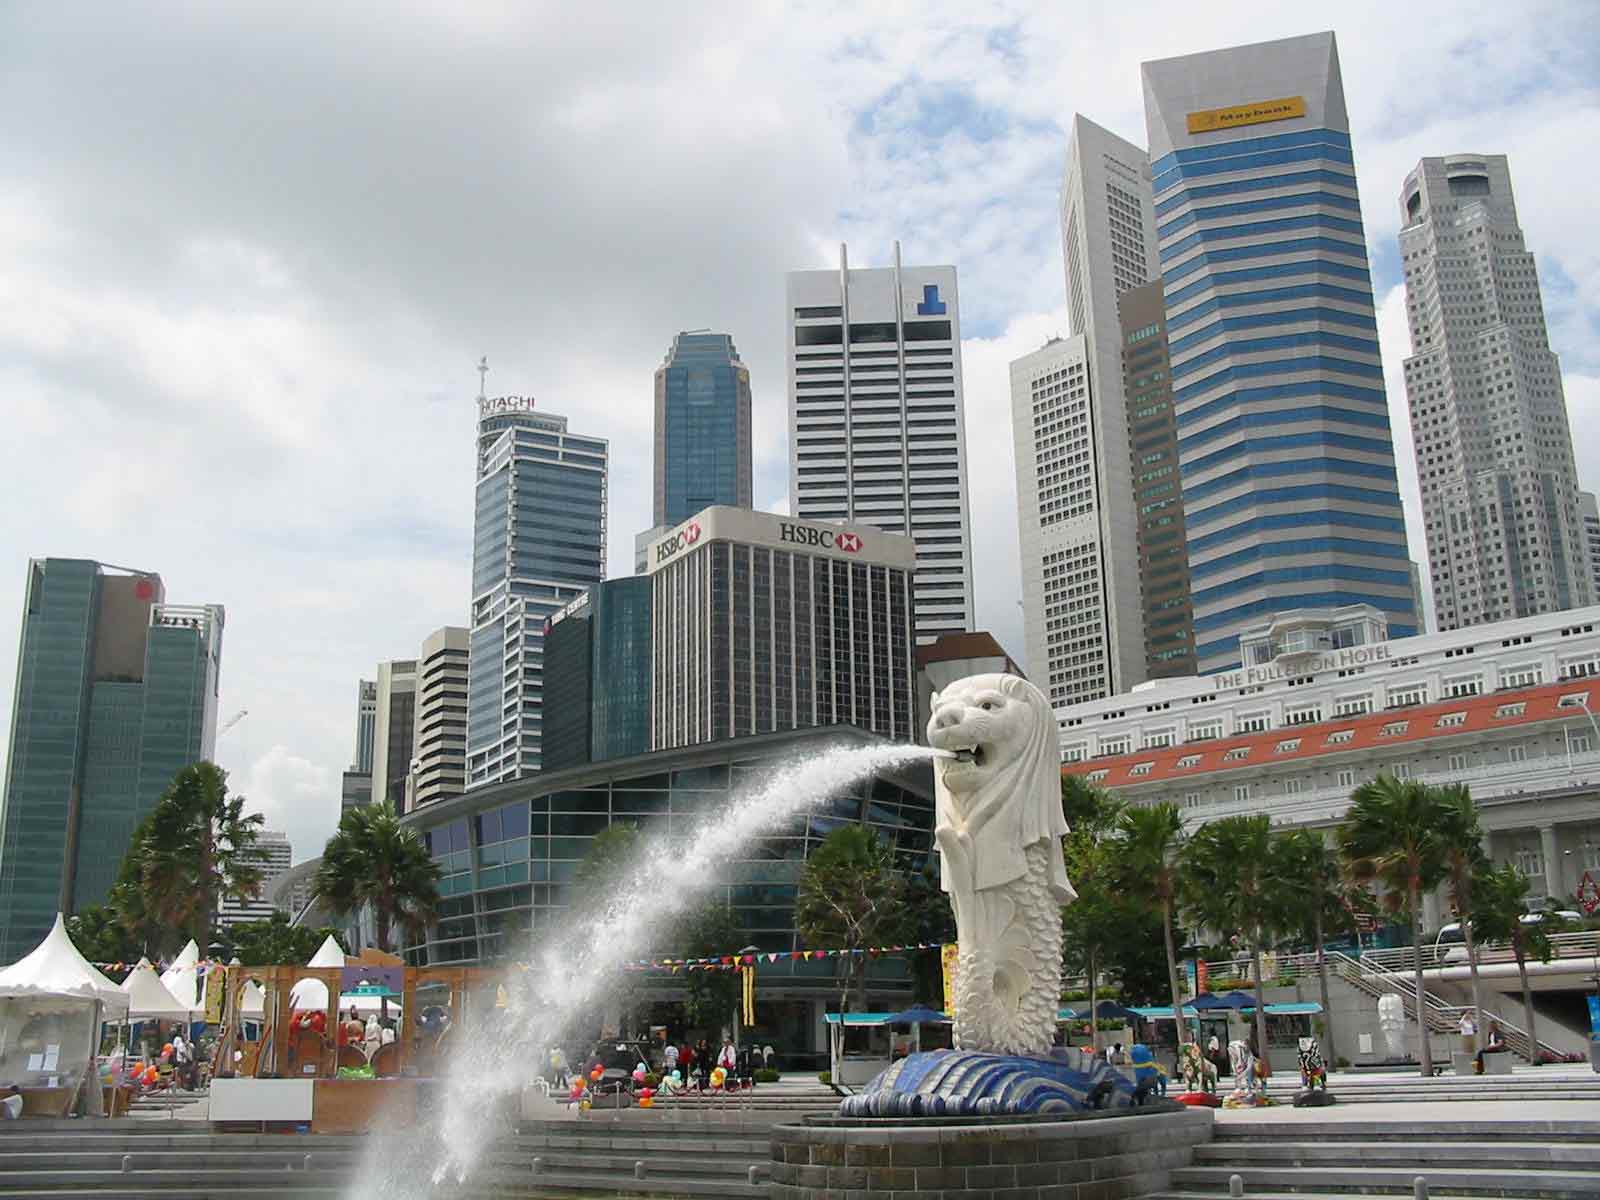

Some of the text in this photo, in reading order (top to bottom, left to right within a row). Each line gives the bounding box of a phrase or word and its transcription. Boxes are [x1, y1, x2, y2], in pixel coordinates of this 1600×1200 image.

[656, 528, 685, 563] HSBC
[780, 522, 833, 548] HSBC
[1215, 672, 1242, 690] THE
[1341, 646, 1392, 667] HOTEL
